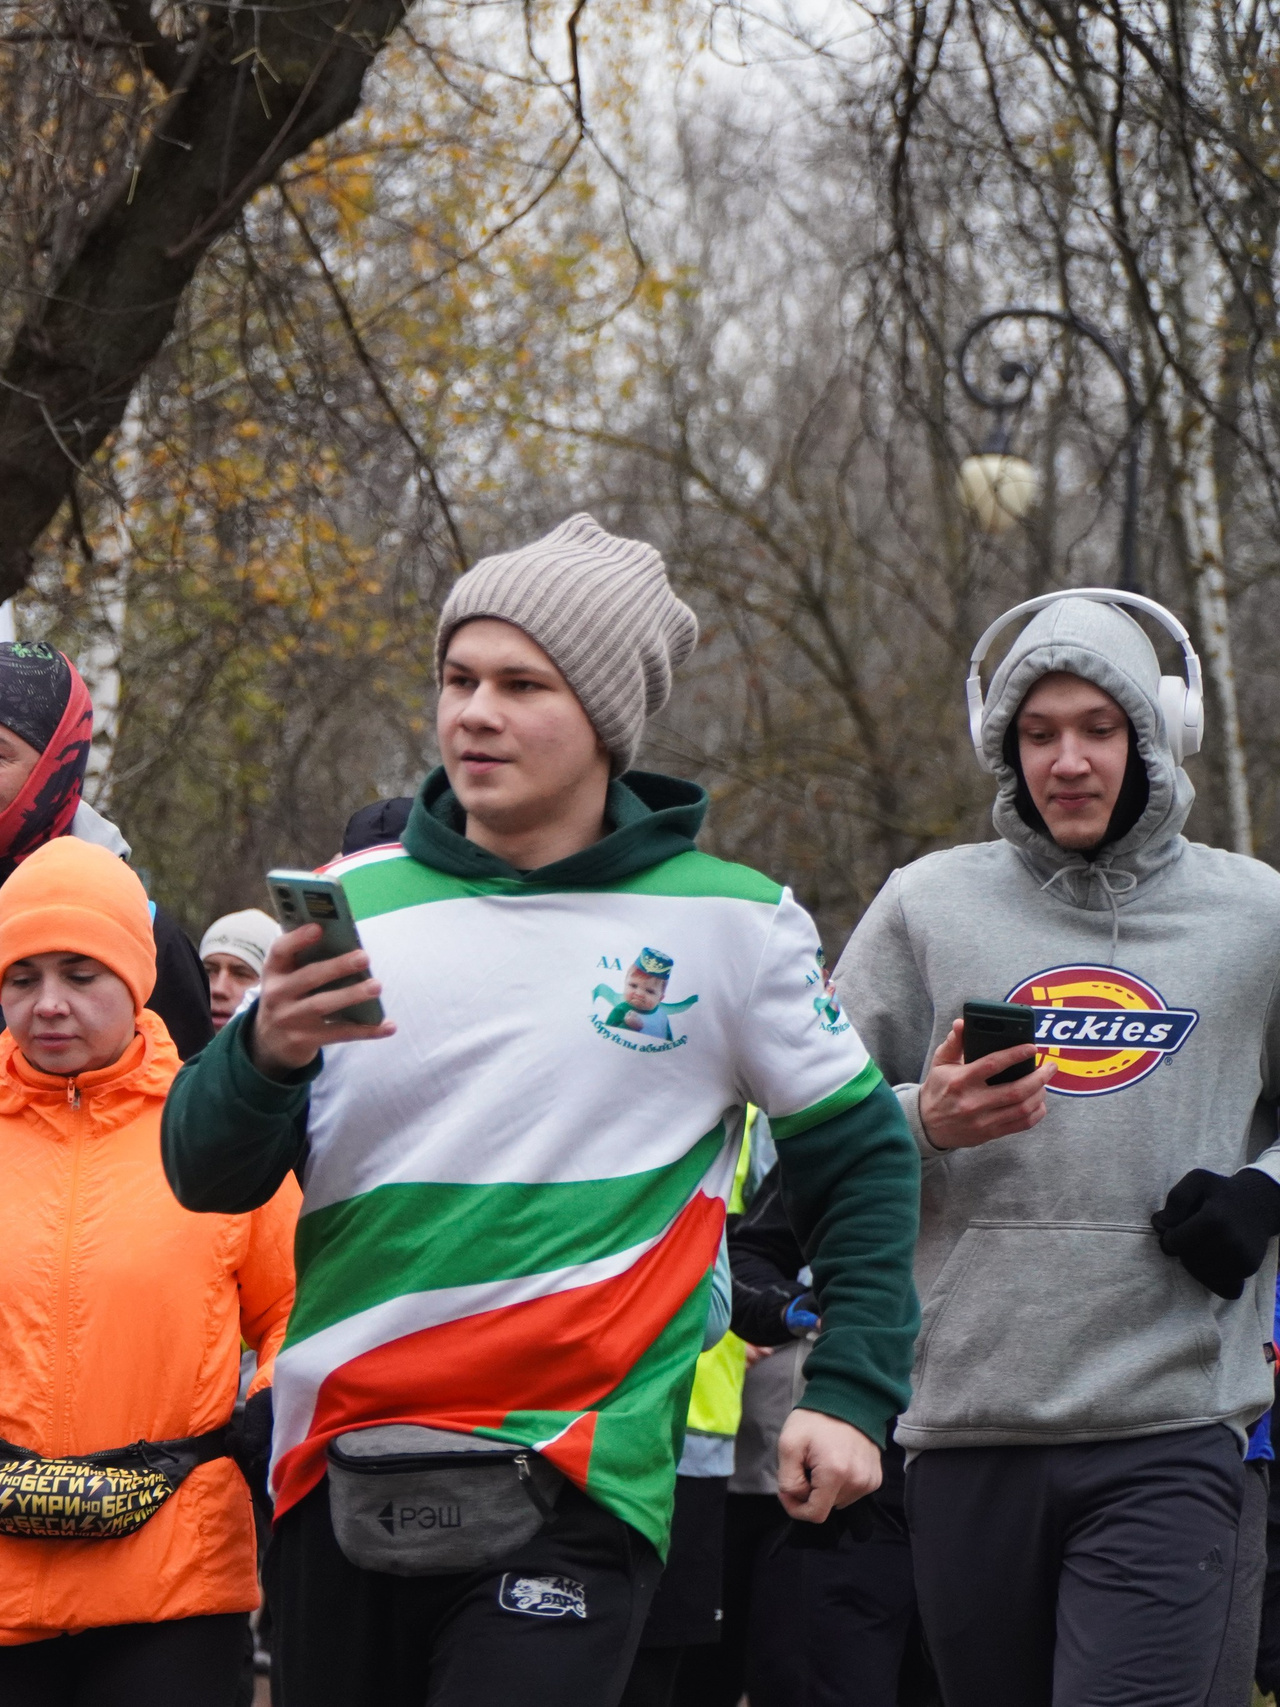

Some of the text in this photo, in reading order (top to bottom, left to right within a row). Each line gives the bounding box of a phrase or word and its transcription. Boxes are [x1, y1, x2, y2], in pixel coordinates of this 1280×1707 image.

[1035, 1013, 1173, 1043] ickies
[20, 1474, 85, 1494] БЕГИ
[105, 1473, 156, 1493] УМРИ
[16, 1493, 81, 1517] УМРИ
[101, 1489, 153, 1519] БЕГИ
[13, 1513, 76, 1531] БЕГИ
[401, 1506, 461, 1529] РЭШ
